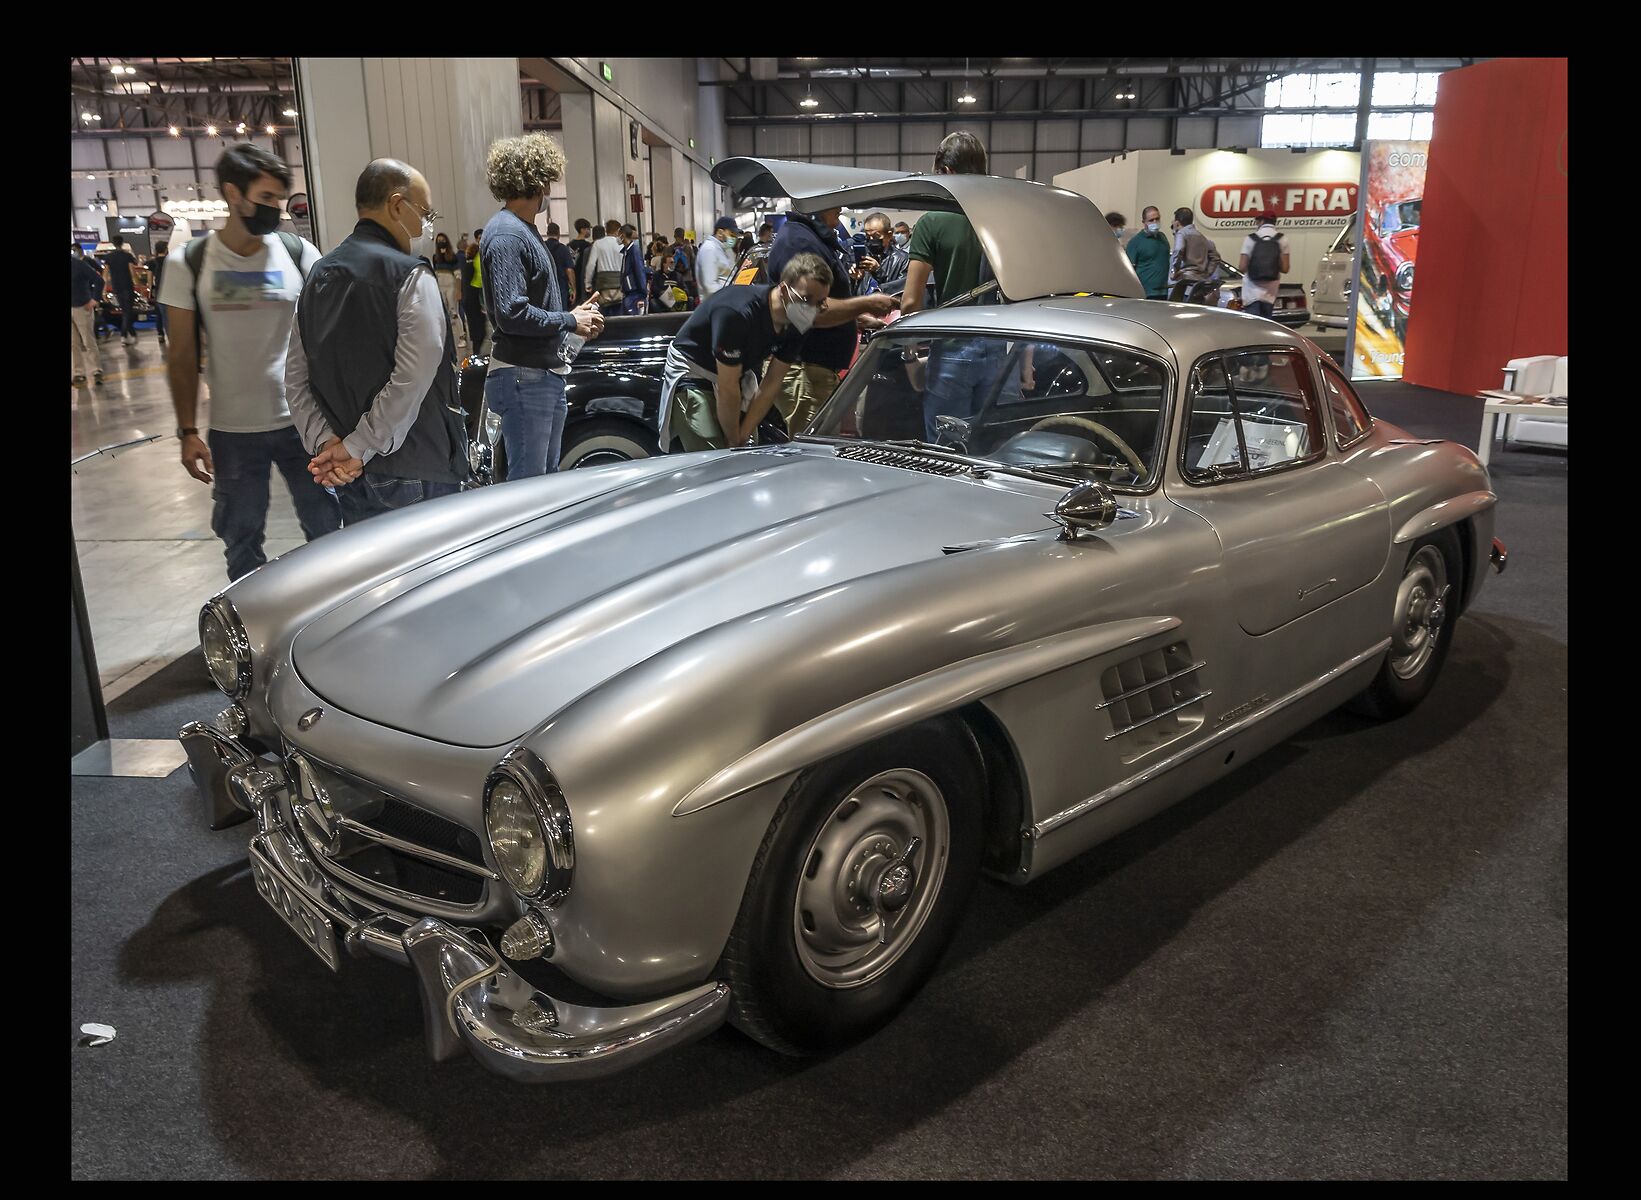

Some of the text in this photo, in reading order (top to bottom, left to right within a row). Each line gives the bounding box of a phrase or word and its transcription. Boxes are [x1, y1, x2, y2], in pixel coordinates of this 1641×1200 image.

[1213, 188, 1351, 212] MA FRA
[1294, 218, 1323, 226] vostra
[1324, 218, 1347, 226] auto
